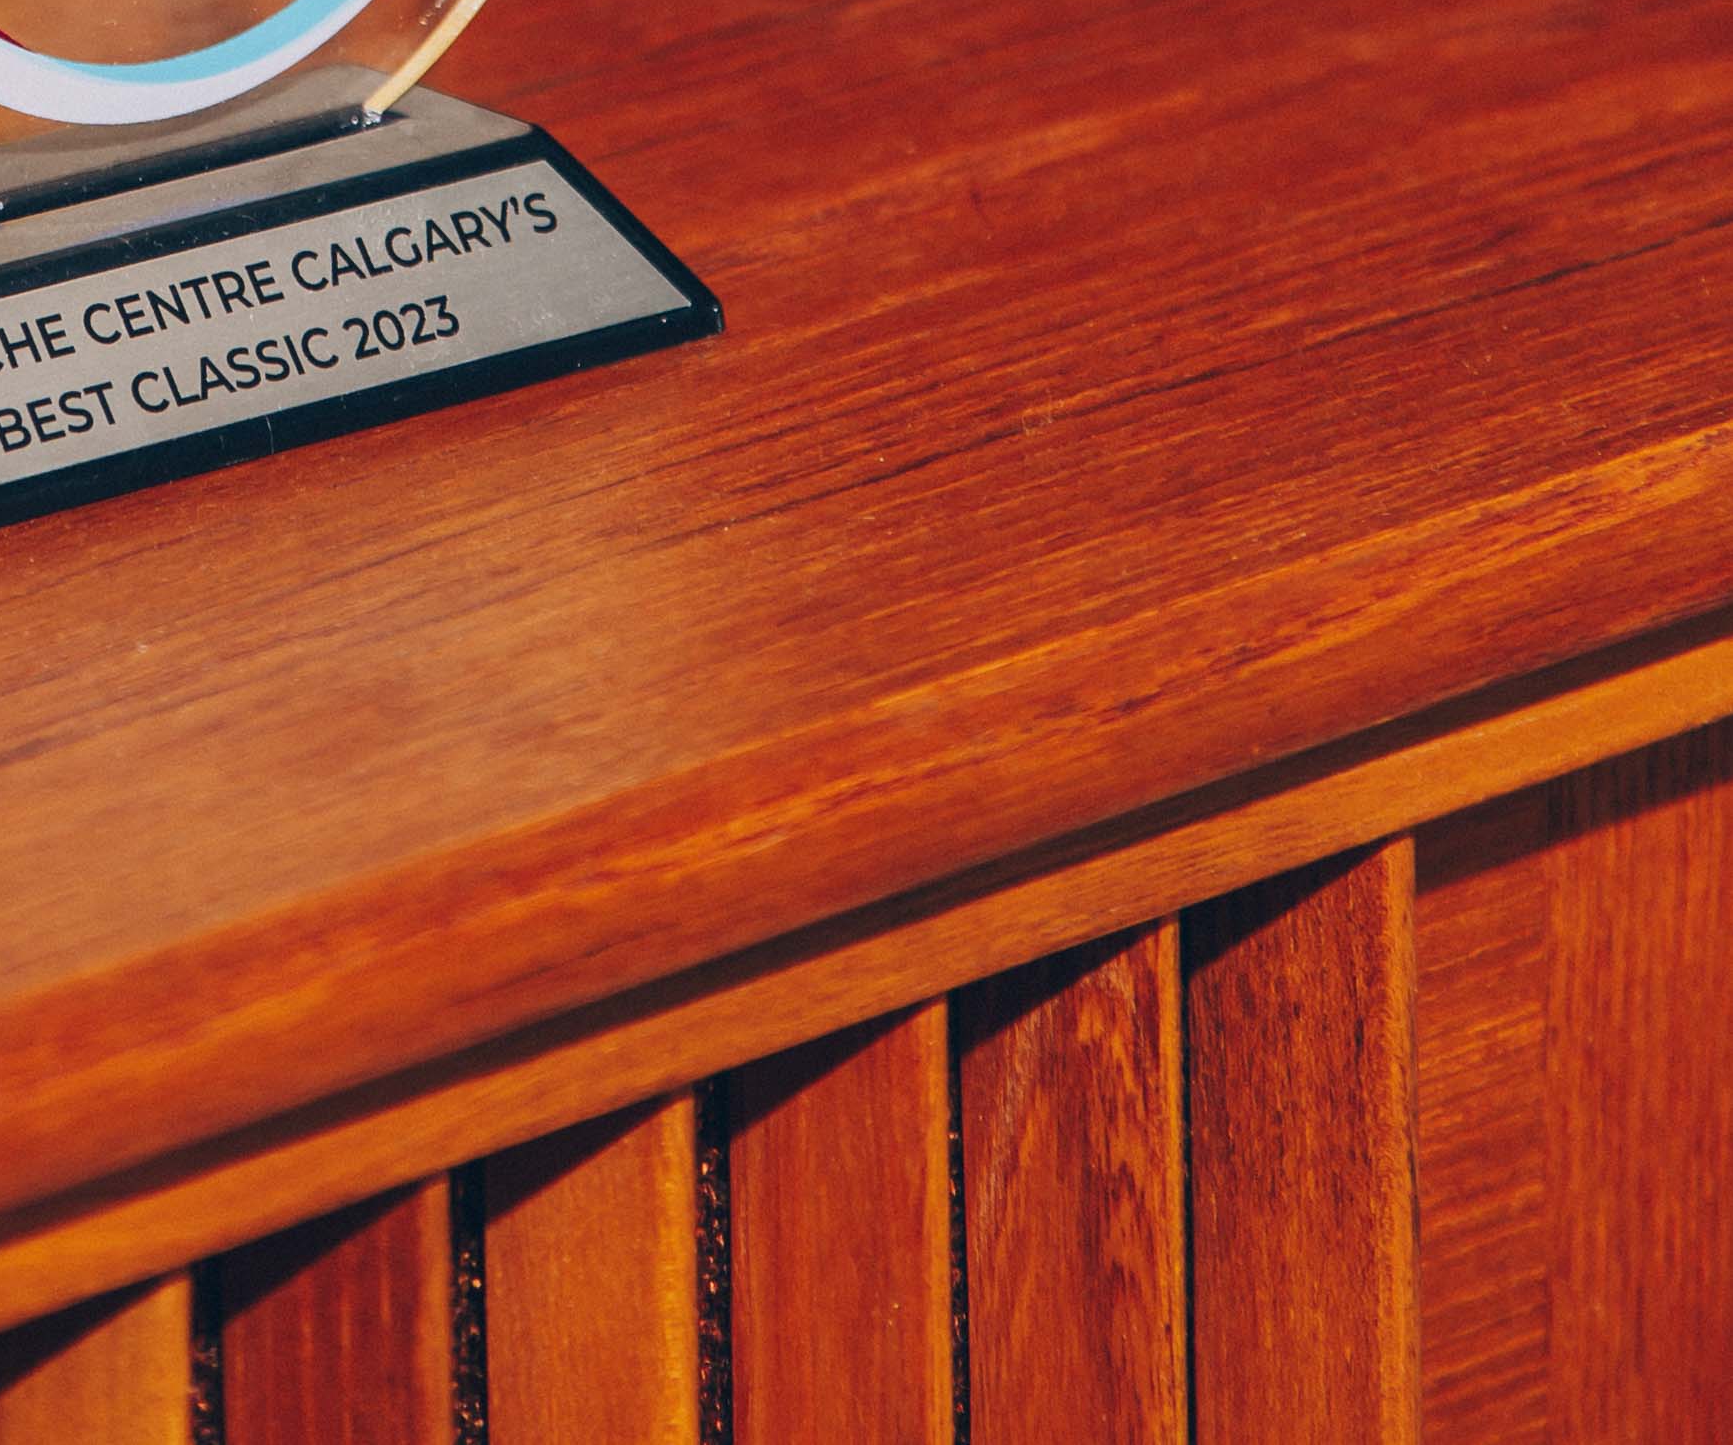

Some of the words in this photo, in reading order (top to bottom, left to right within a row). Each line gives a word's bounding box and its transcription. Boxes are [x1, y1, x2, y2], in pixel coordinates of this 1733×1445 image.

[83, 260, 285, 345] CENTRE
[291, 192, 558, 292] CALGARY'S
[131, 327, 339, 413] CLASSIC
[343, 294, 460, 361] 2023
